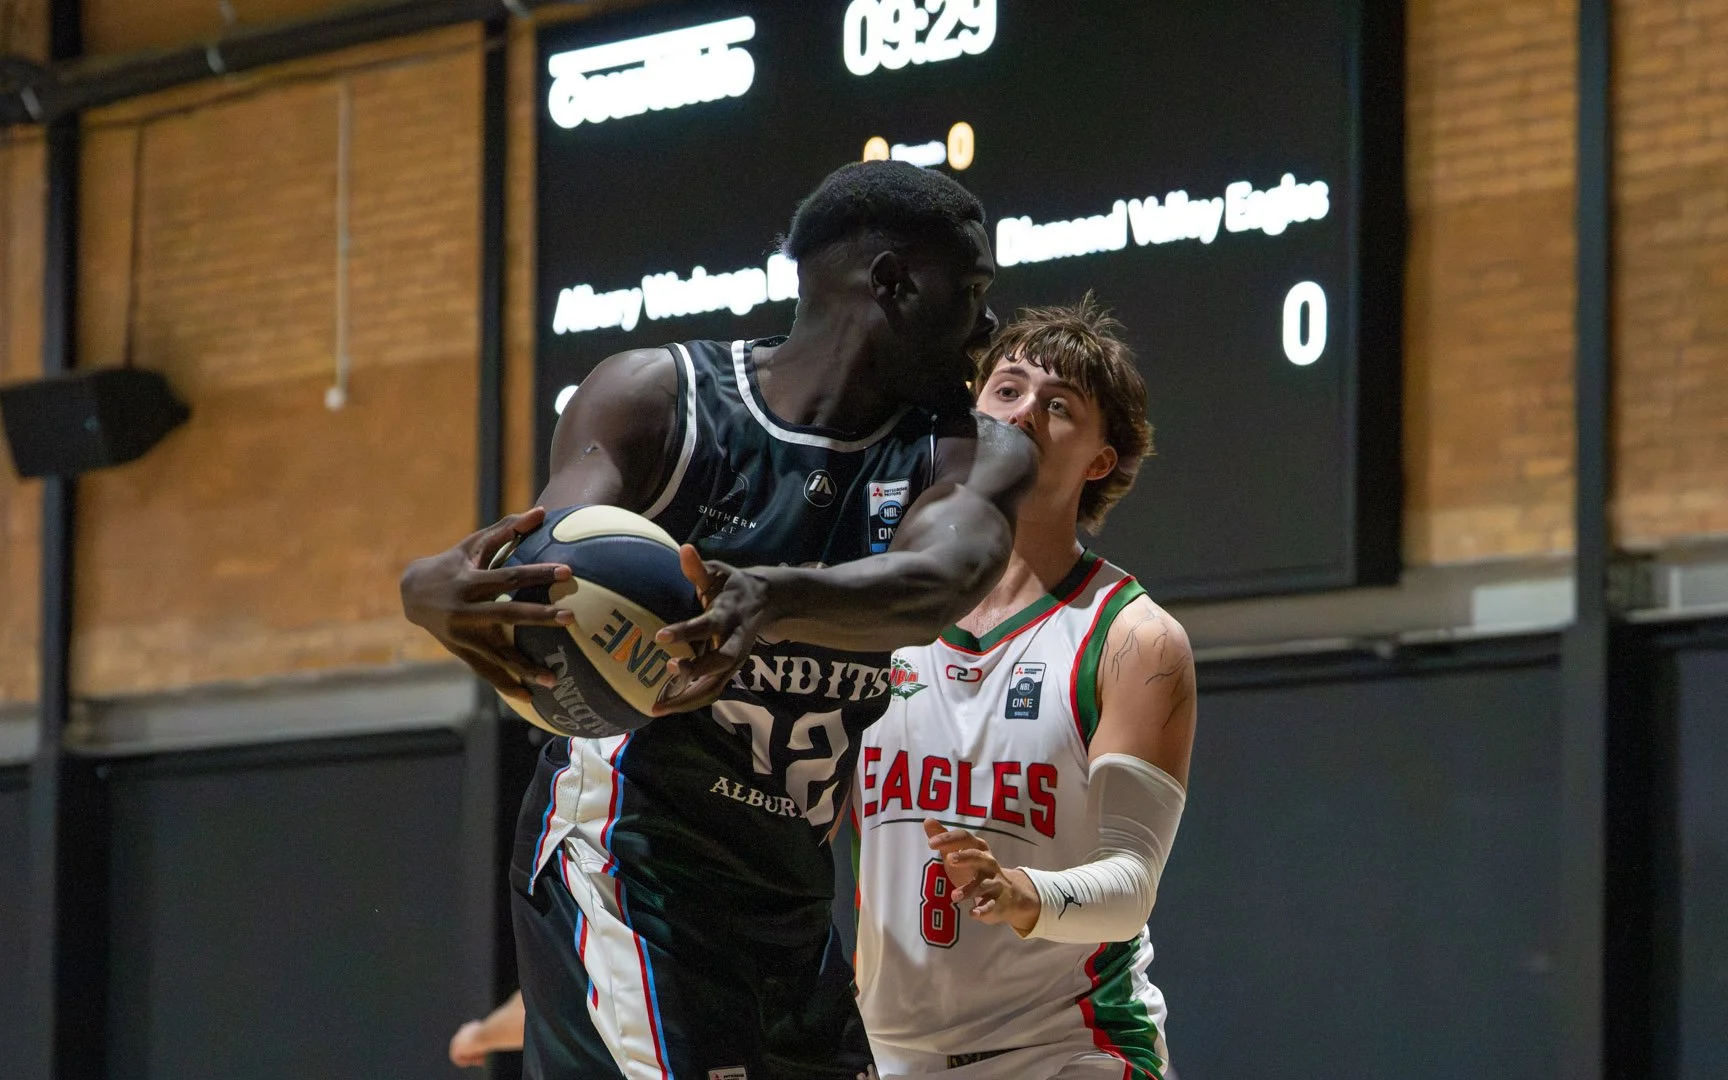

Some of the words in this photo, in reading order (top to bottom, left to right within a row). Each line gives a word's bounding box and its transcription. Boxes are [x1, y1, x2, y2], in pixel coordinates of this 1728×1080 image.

[842, 0, 997, 75] 09:29
[1282, 280, 1327, 366] 0
[878, 527, 897, 540] ON
[730, 654, 892, 701] NDITS
[1012, 697, 1034, 709] ONE
[709, 776, 809, 819] ALBUR
[864, 746, 1058, 839] EAGLES
[919, 857, 961, 949] 8
